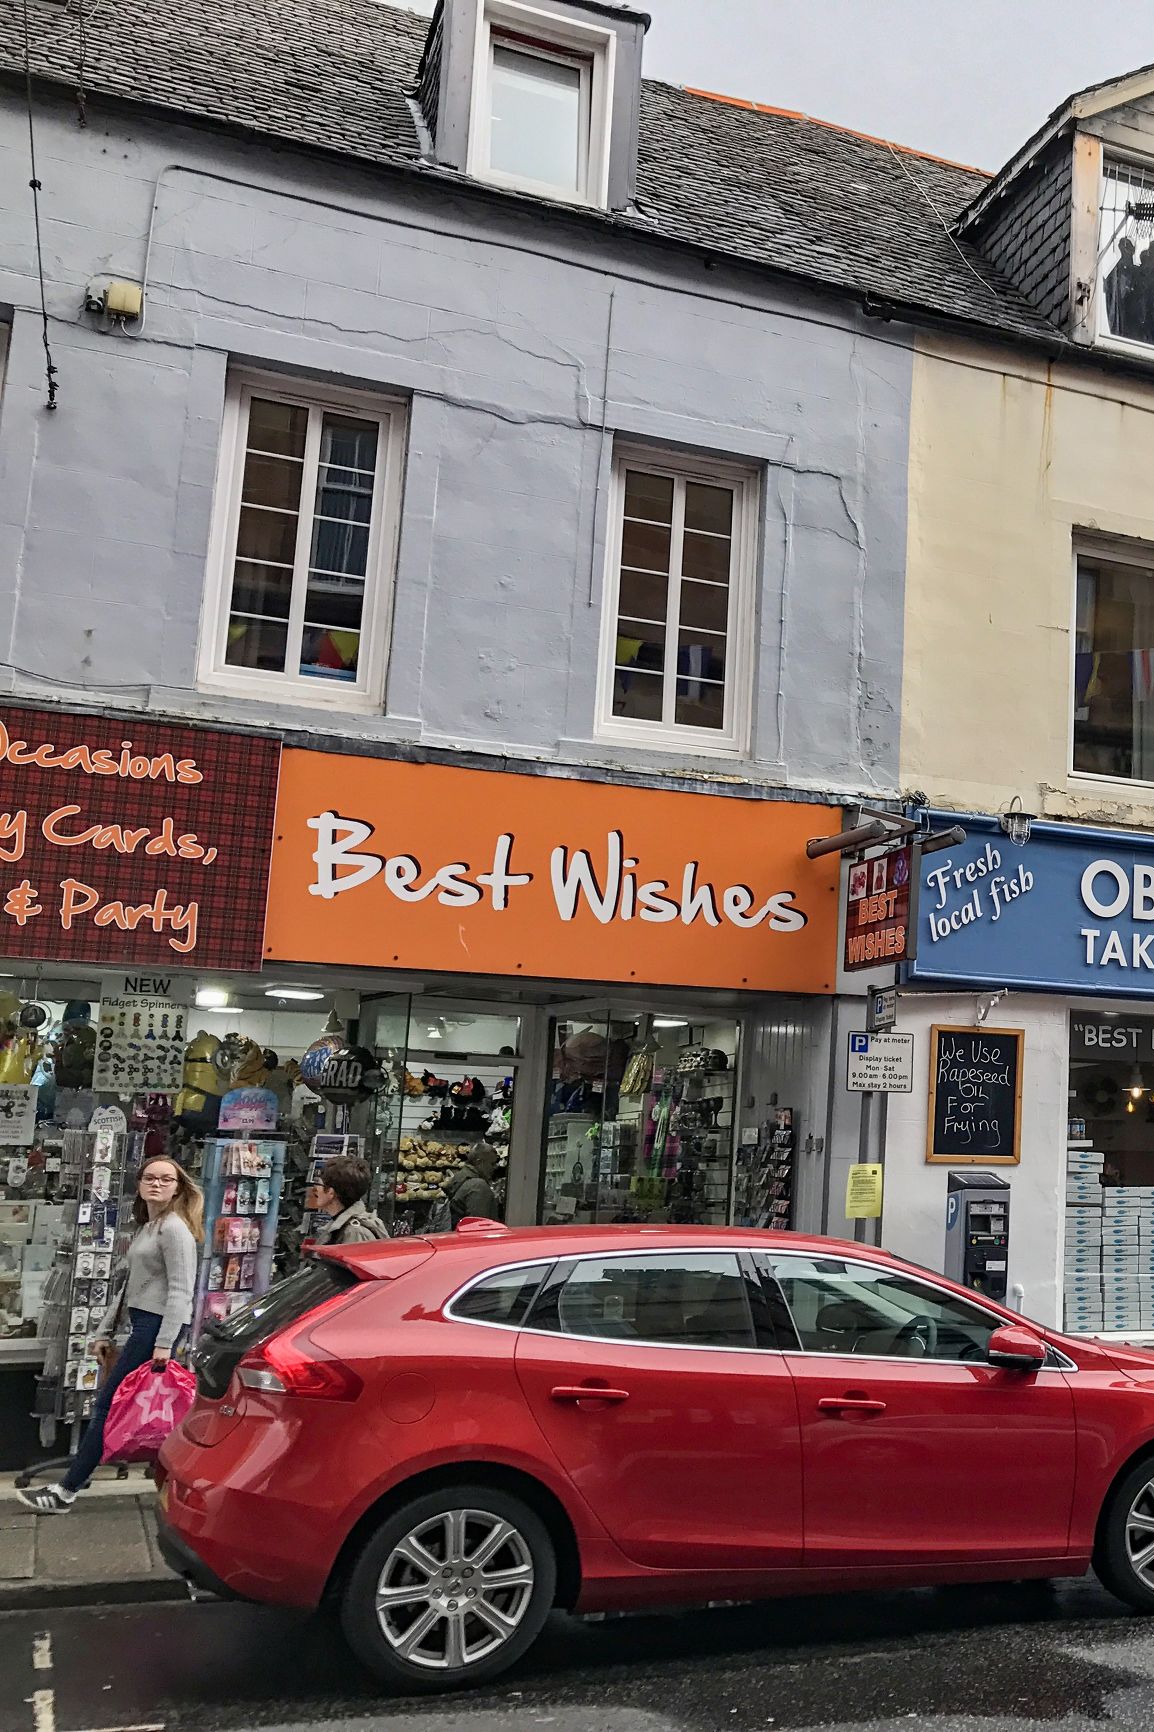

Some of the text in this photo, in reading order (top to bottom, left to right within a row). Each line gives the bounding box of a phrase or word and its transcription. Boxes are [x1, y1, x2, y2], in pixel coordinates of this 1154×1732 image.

[42, 805, 218, 865] Cards,
[306, 810, 808, 933] Best Wishes
[927, 842, 1002, 909] Fresh
[4, 878, 199, 953] & Party
[858, 889, 898, 925] BEST
[929, 863, 1034, 942] local fish
[847, 925, 906, 964] WISHES
[124, 976, 172, 994] NEW
[102, 996, 188, 1011] Fidget Spinners
[855, 1036, 866, 1051] P
[870, 1036, 882, 1044] Pay
[858, 1054, 902, 1063] Display ticket
[940, 1037, 1004, 1065] We Use
[320, 1060, 362, 1088] GRAD
[888, 1082, 907, 1090] hours
[937, 1057, 1011, 1090] Rapeseed
[947, 1096, 985, 1115] For
[943, 1115, 1001, 1148] Frying
[947, 1197, 956, 1224] P
